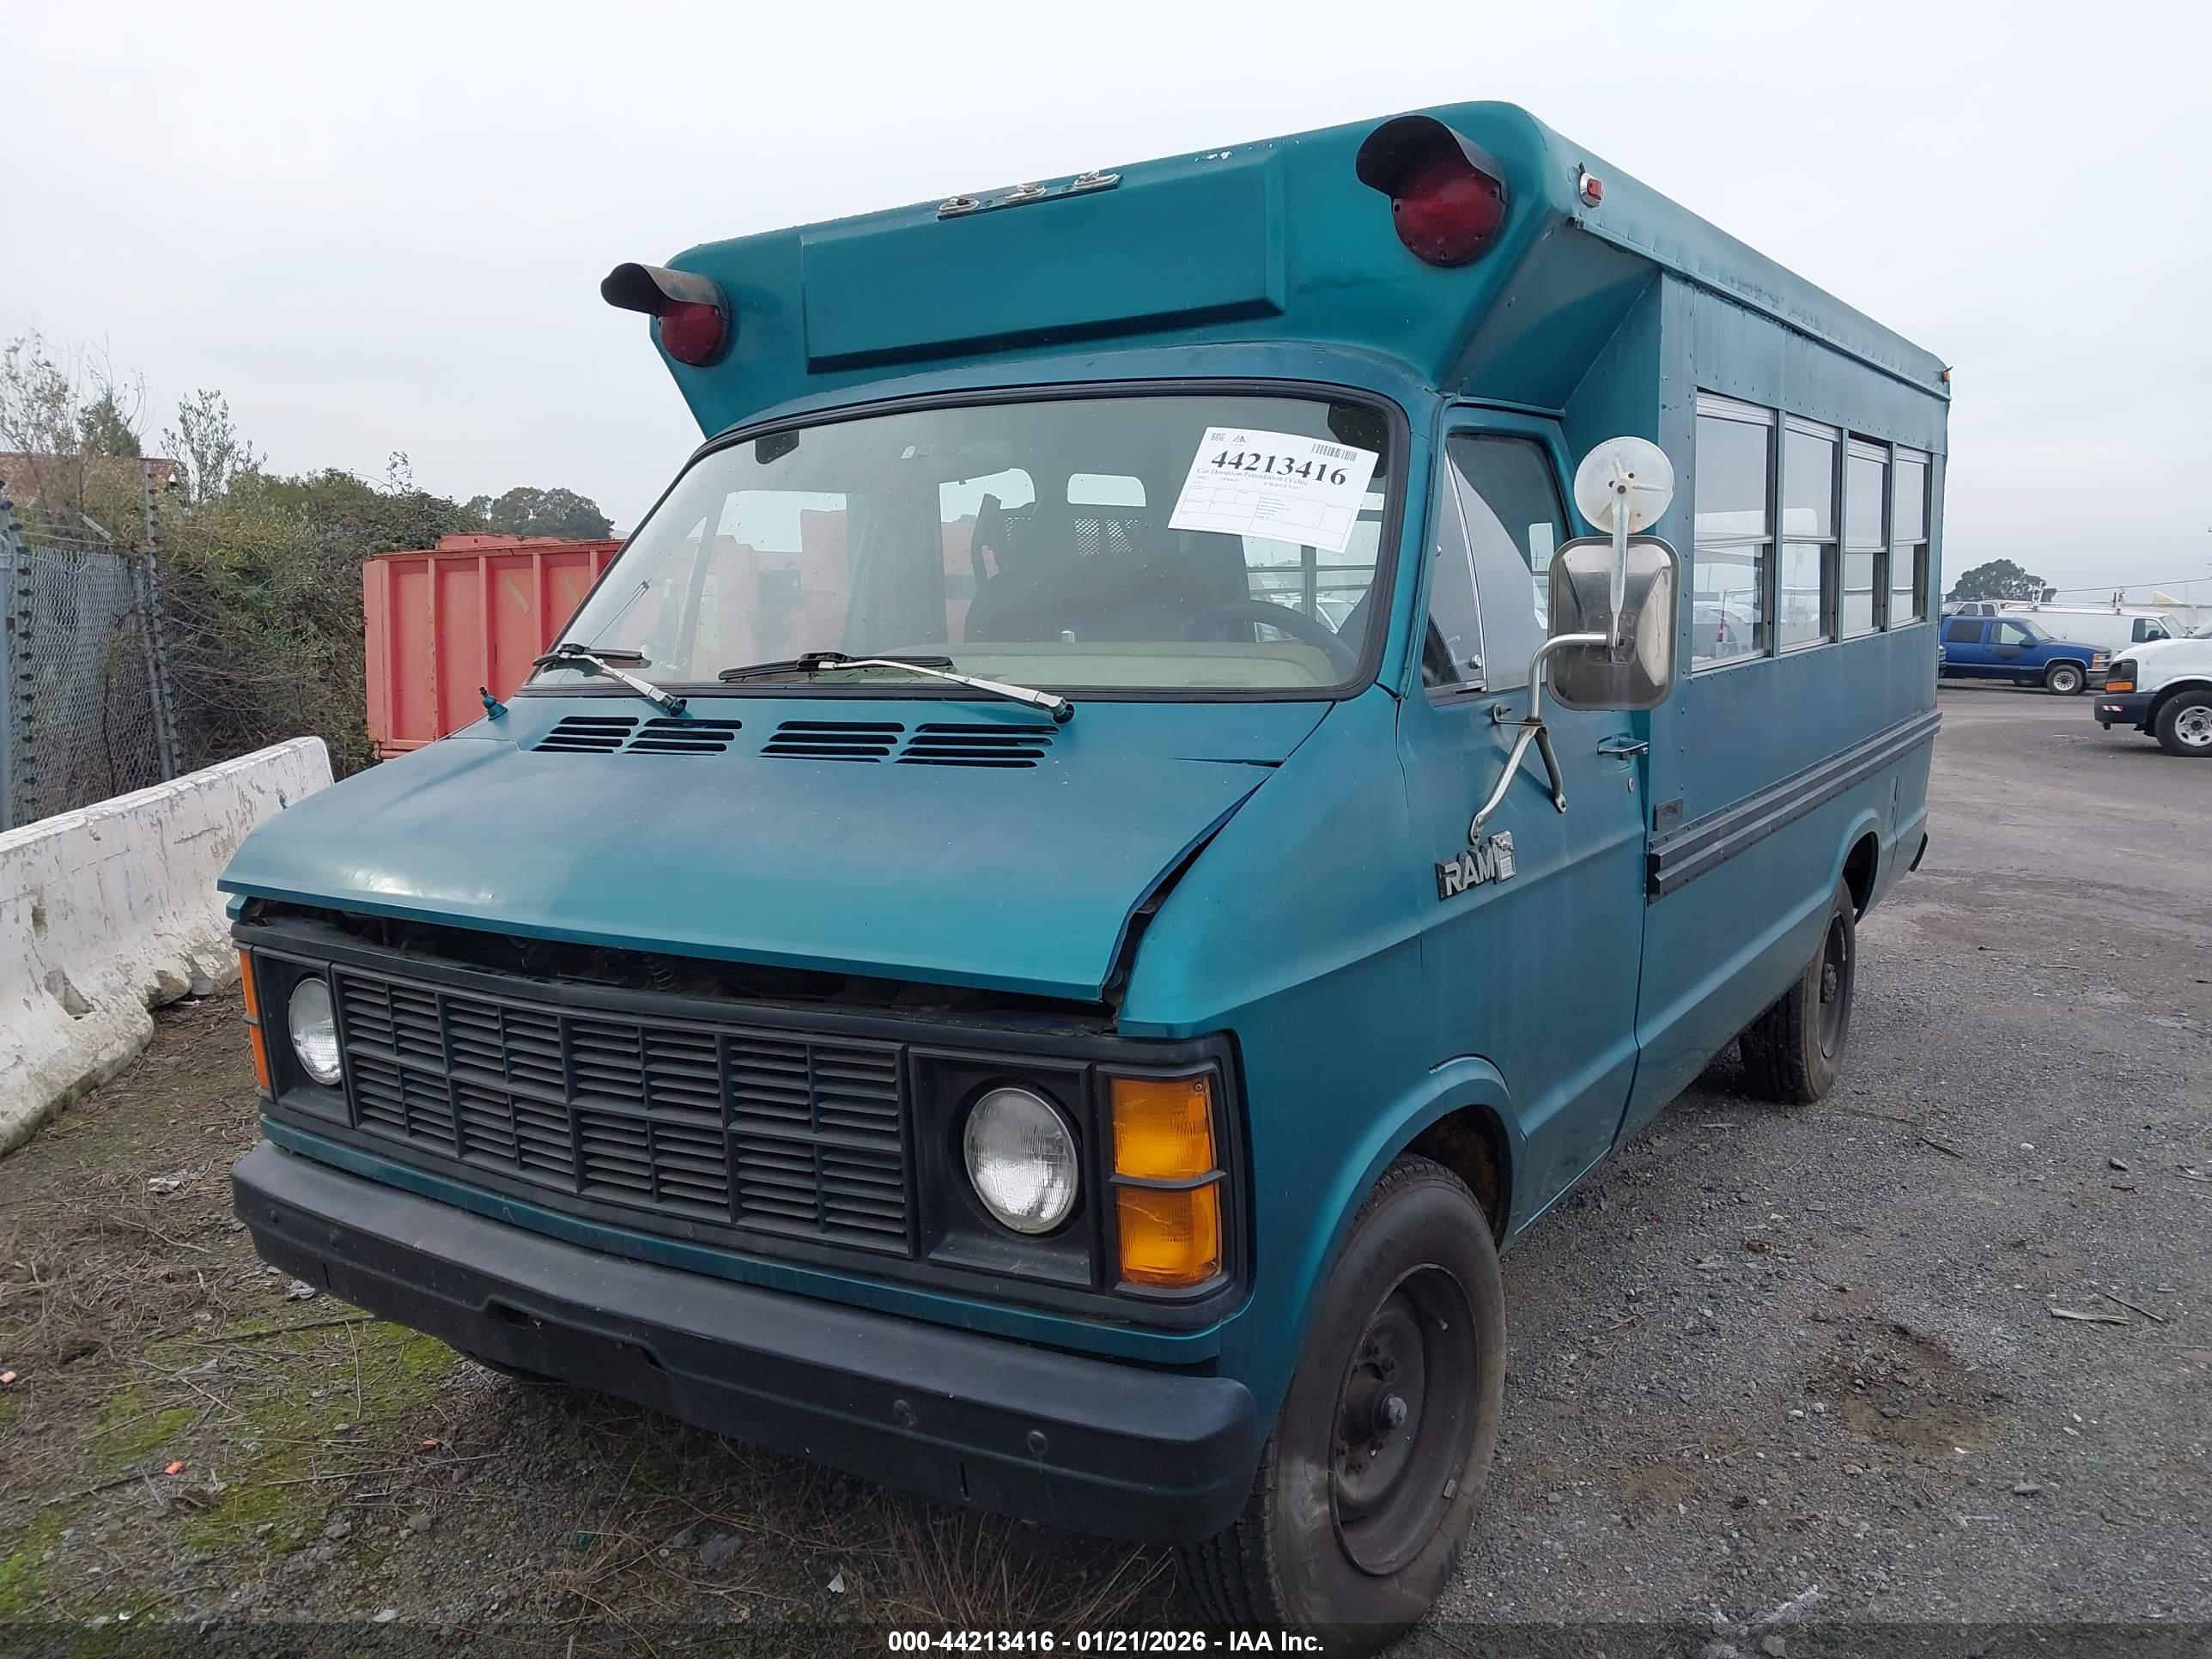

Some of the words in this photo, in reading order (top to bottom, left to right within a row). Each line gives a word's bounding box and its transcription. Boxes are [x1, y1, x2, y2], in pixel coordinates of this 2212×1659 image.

[1211, 450, 1350, 486] 44213416
[1211, 469, 1243, 477] Donation
[1244, 471, 1283, 481] Foundation
[1437, 845, 1496, 898] RAM
